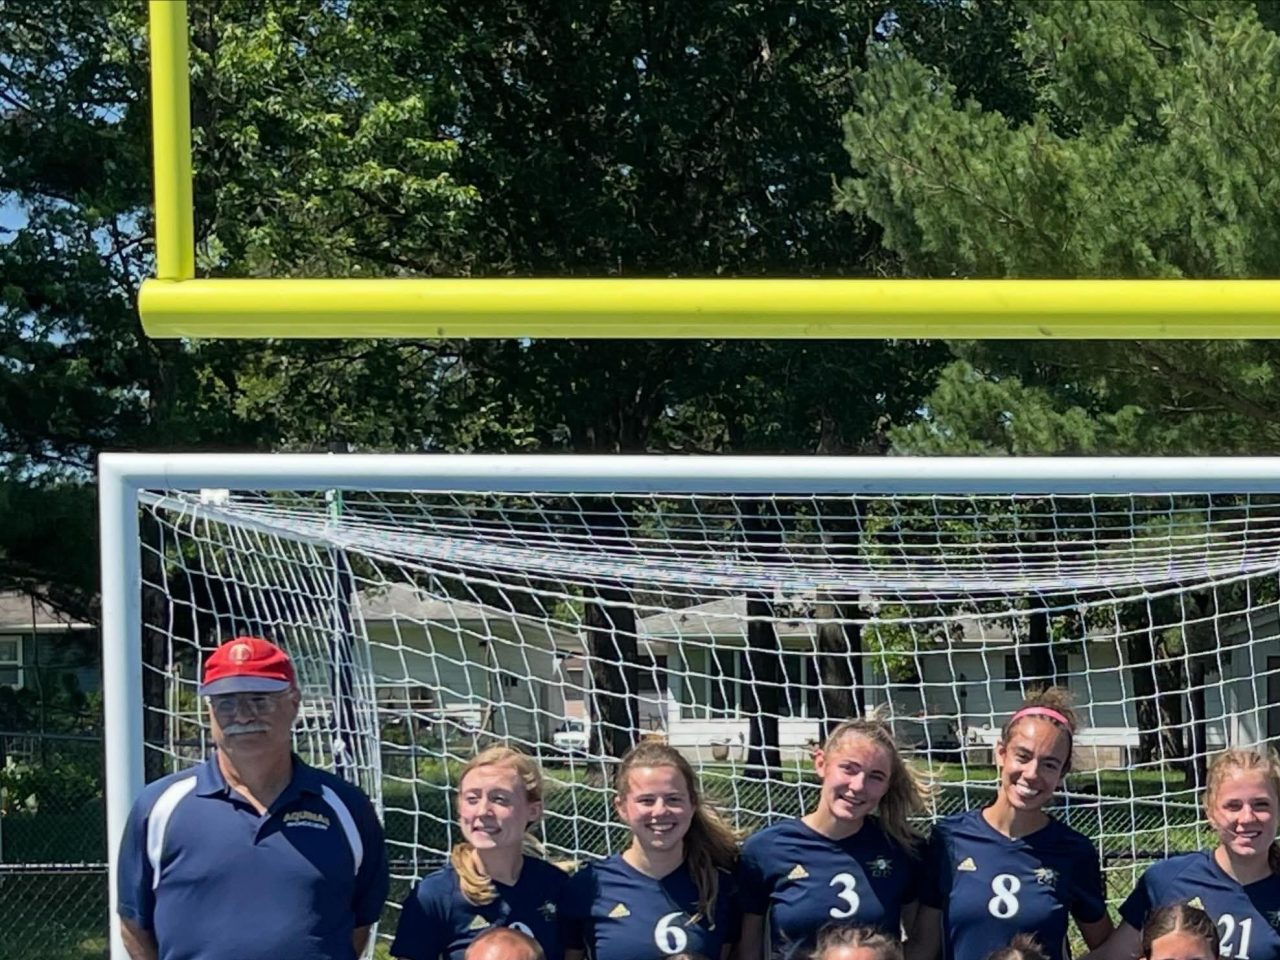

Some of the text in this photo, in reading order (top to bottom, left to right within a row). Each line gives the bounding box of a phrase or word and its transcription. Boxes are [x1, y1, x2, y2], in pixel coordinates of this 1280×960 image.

[830, 873, 859, 918] 3
[989, 874, 1020, 918] 8
[655, 912, 687, 954] 6
[1217, 914, 1252, 960] 21
